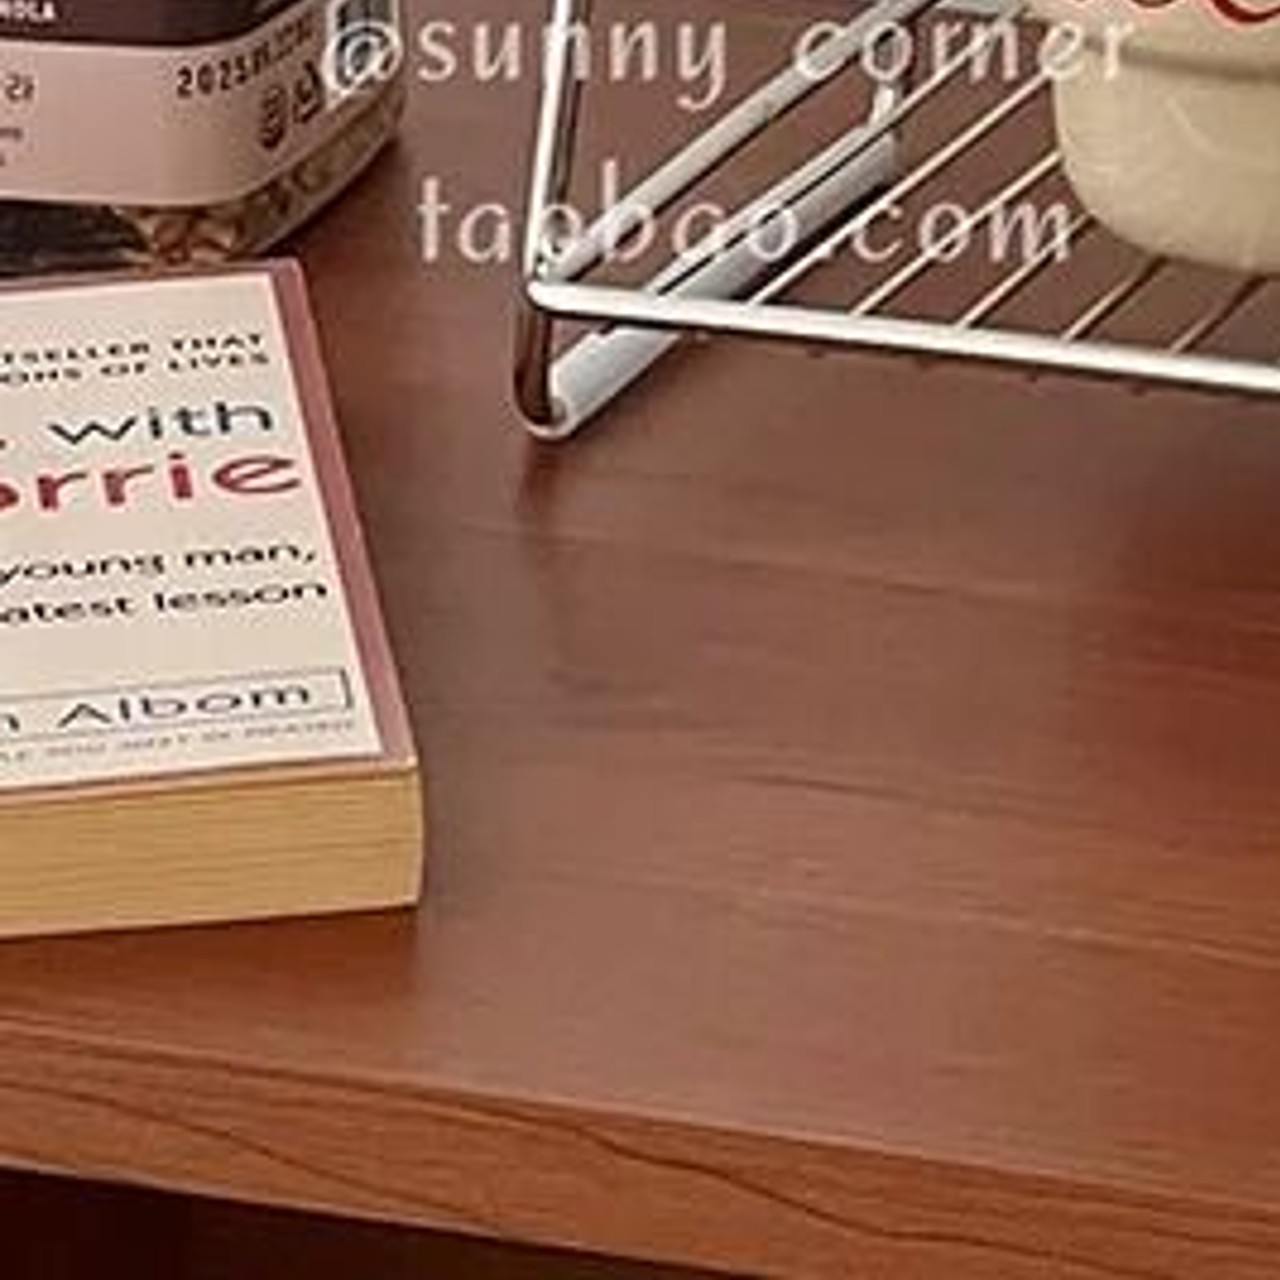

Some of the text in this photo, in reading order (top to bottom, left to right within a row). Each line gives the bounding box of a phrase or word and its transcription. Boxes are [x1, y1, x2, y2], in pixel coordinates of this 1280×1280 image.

[47, 400, 274, 445] with
[184, 543, 317, 568] man,
[153, 582, 329, 612] lesson
[56, 687, 311, 729] Albom
